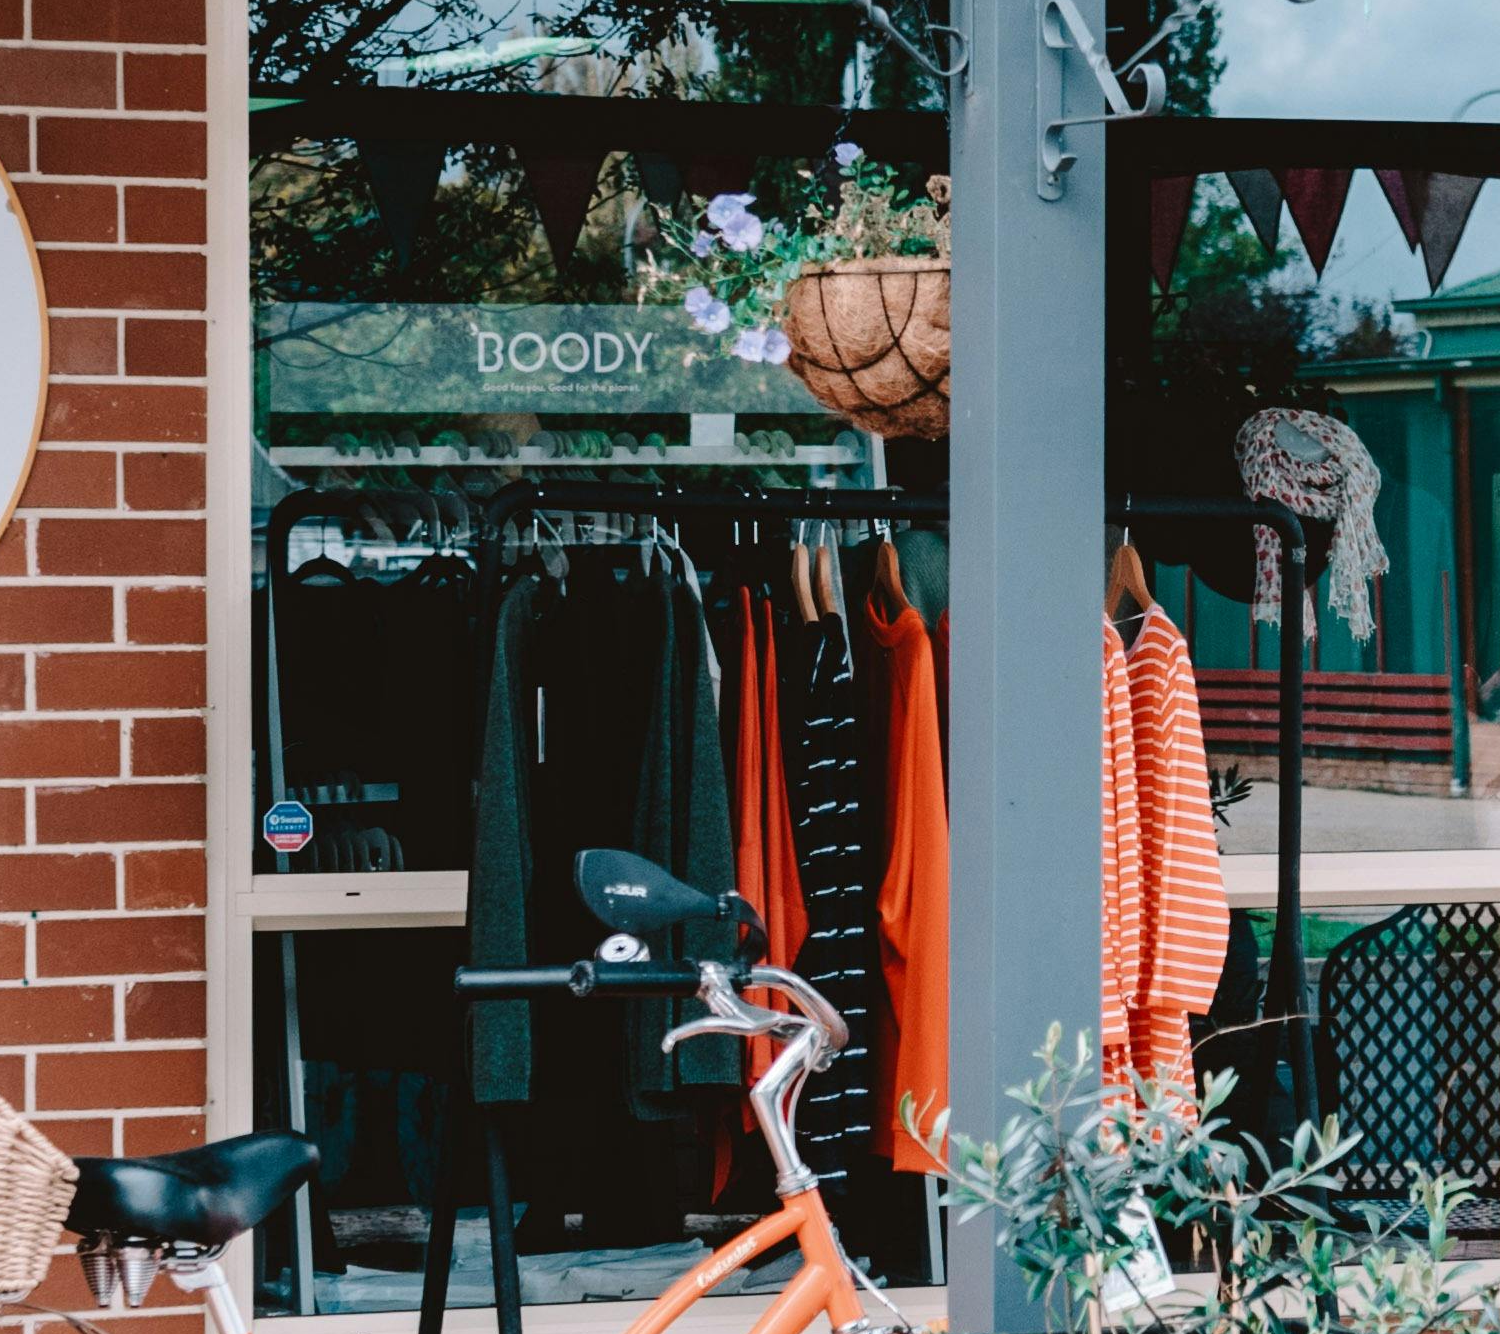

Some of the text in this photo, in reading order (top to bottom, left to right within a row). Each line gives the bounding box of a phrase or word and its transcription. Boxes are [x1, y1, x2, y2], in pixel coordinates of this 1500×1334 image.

[477, 331, 653, 373] BOODY
[483, 382, 509, 393] Good
[549, 382, 574, 393] Good
[575, 382, 590, 393] for
[591, 382, 606, 393] the
